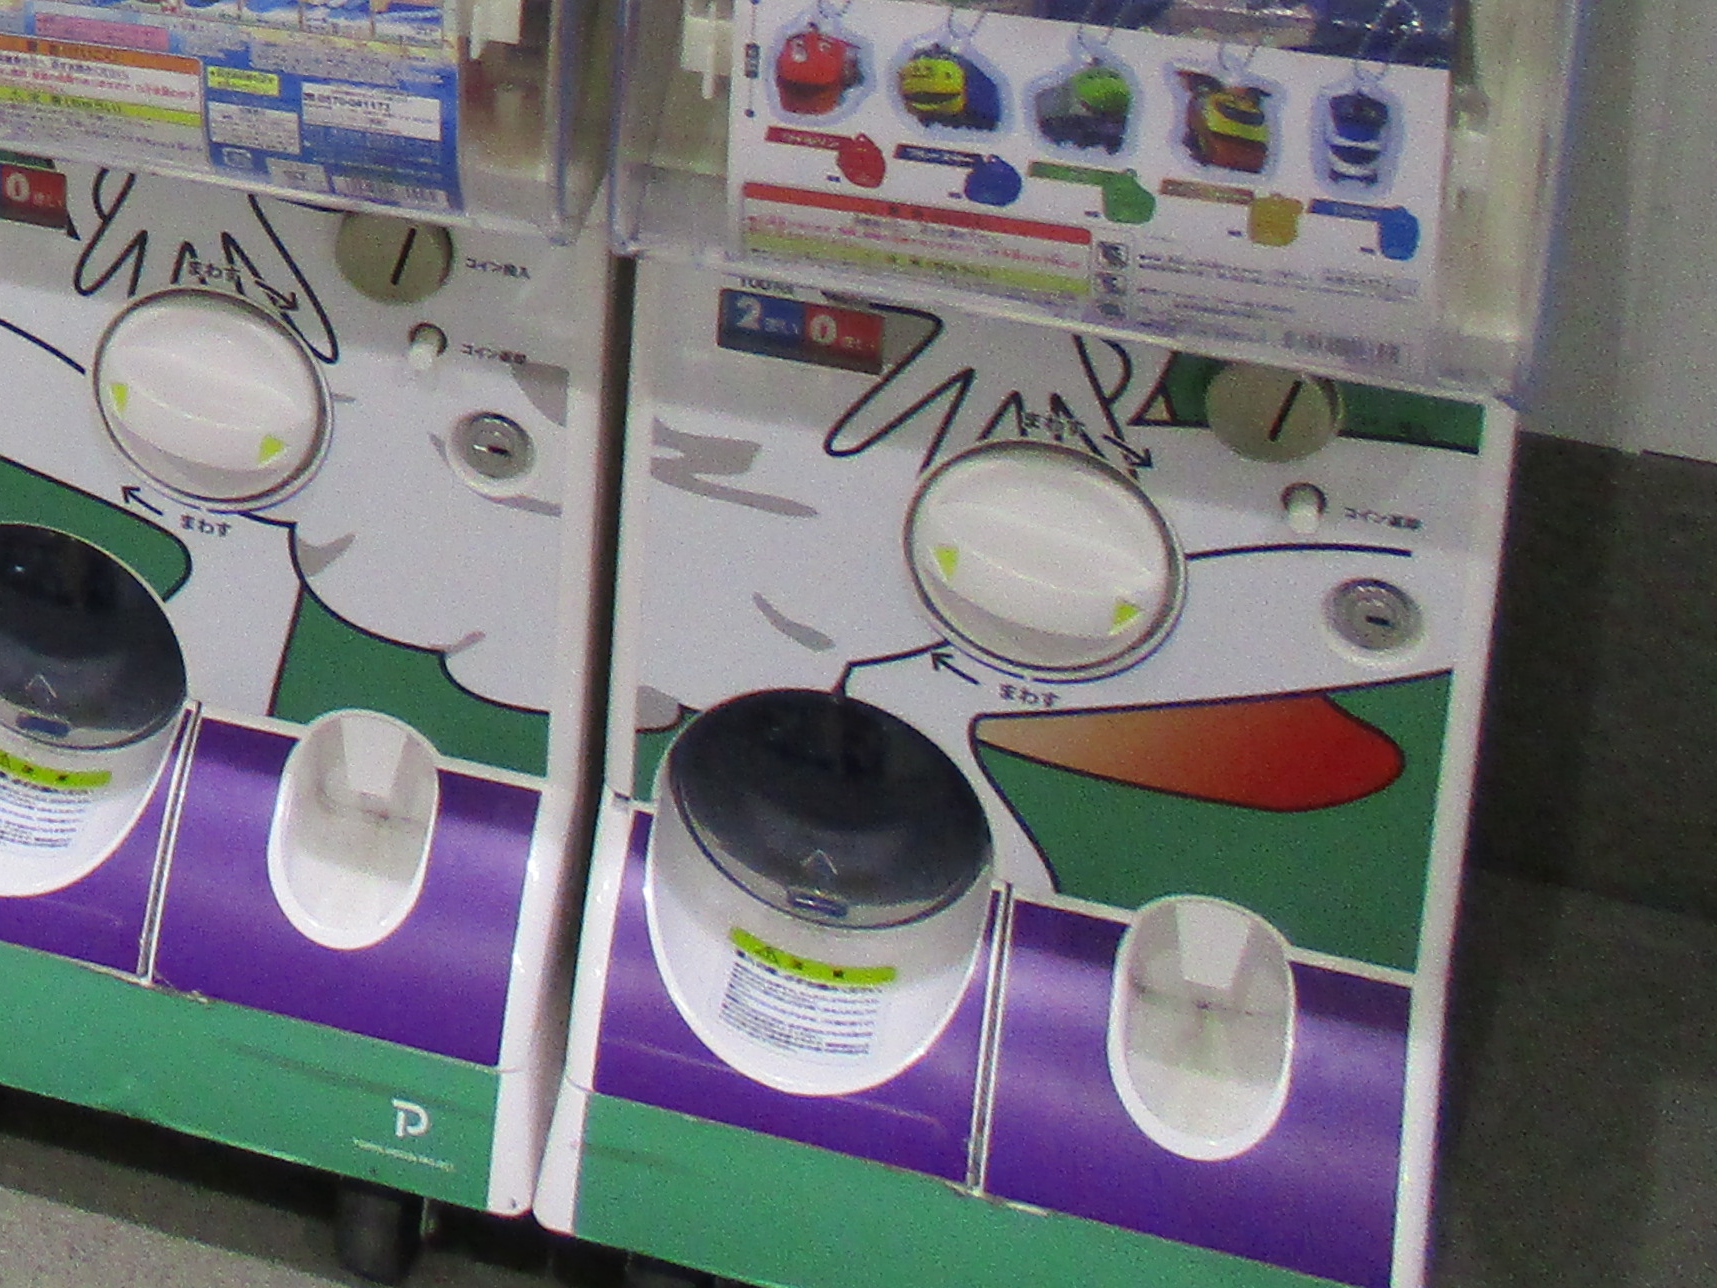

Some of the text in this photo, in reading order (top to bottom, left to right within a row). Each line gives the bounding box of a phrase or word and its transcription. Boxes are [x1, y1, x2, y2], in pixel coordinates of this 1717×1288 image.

[180, 514, 232, 538] まわす
[999, 682, 1062, 708] まわす
